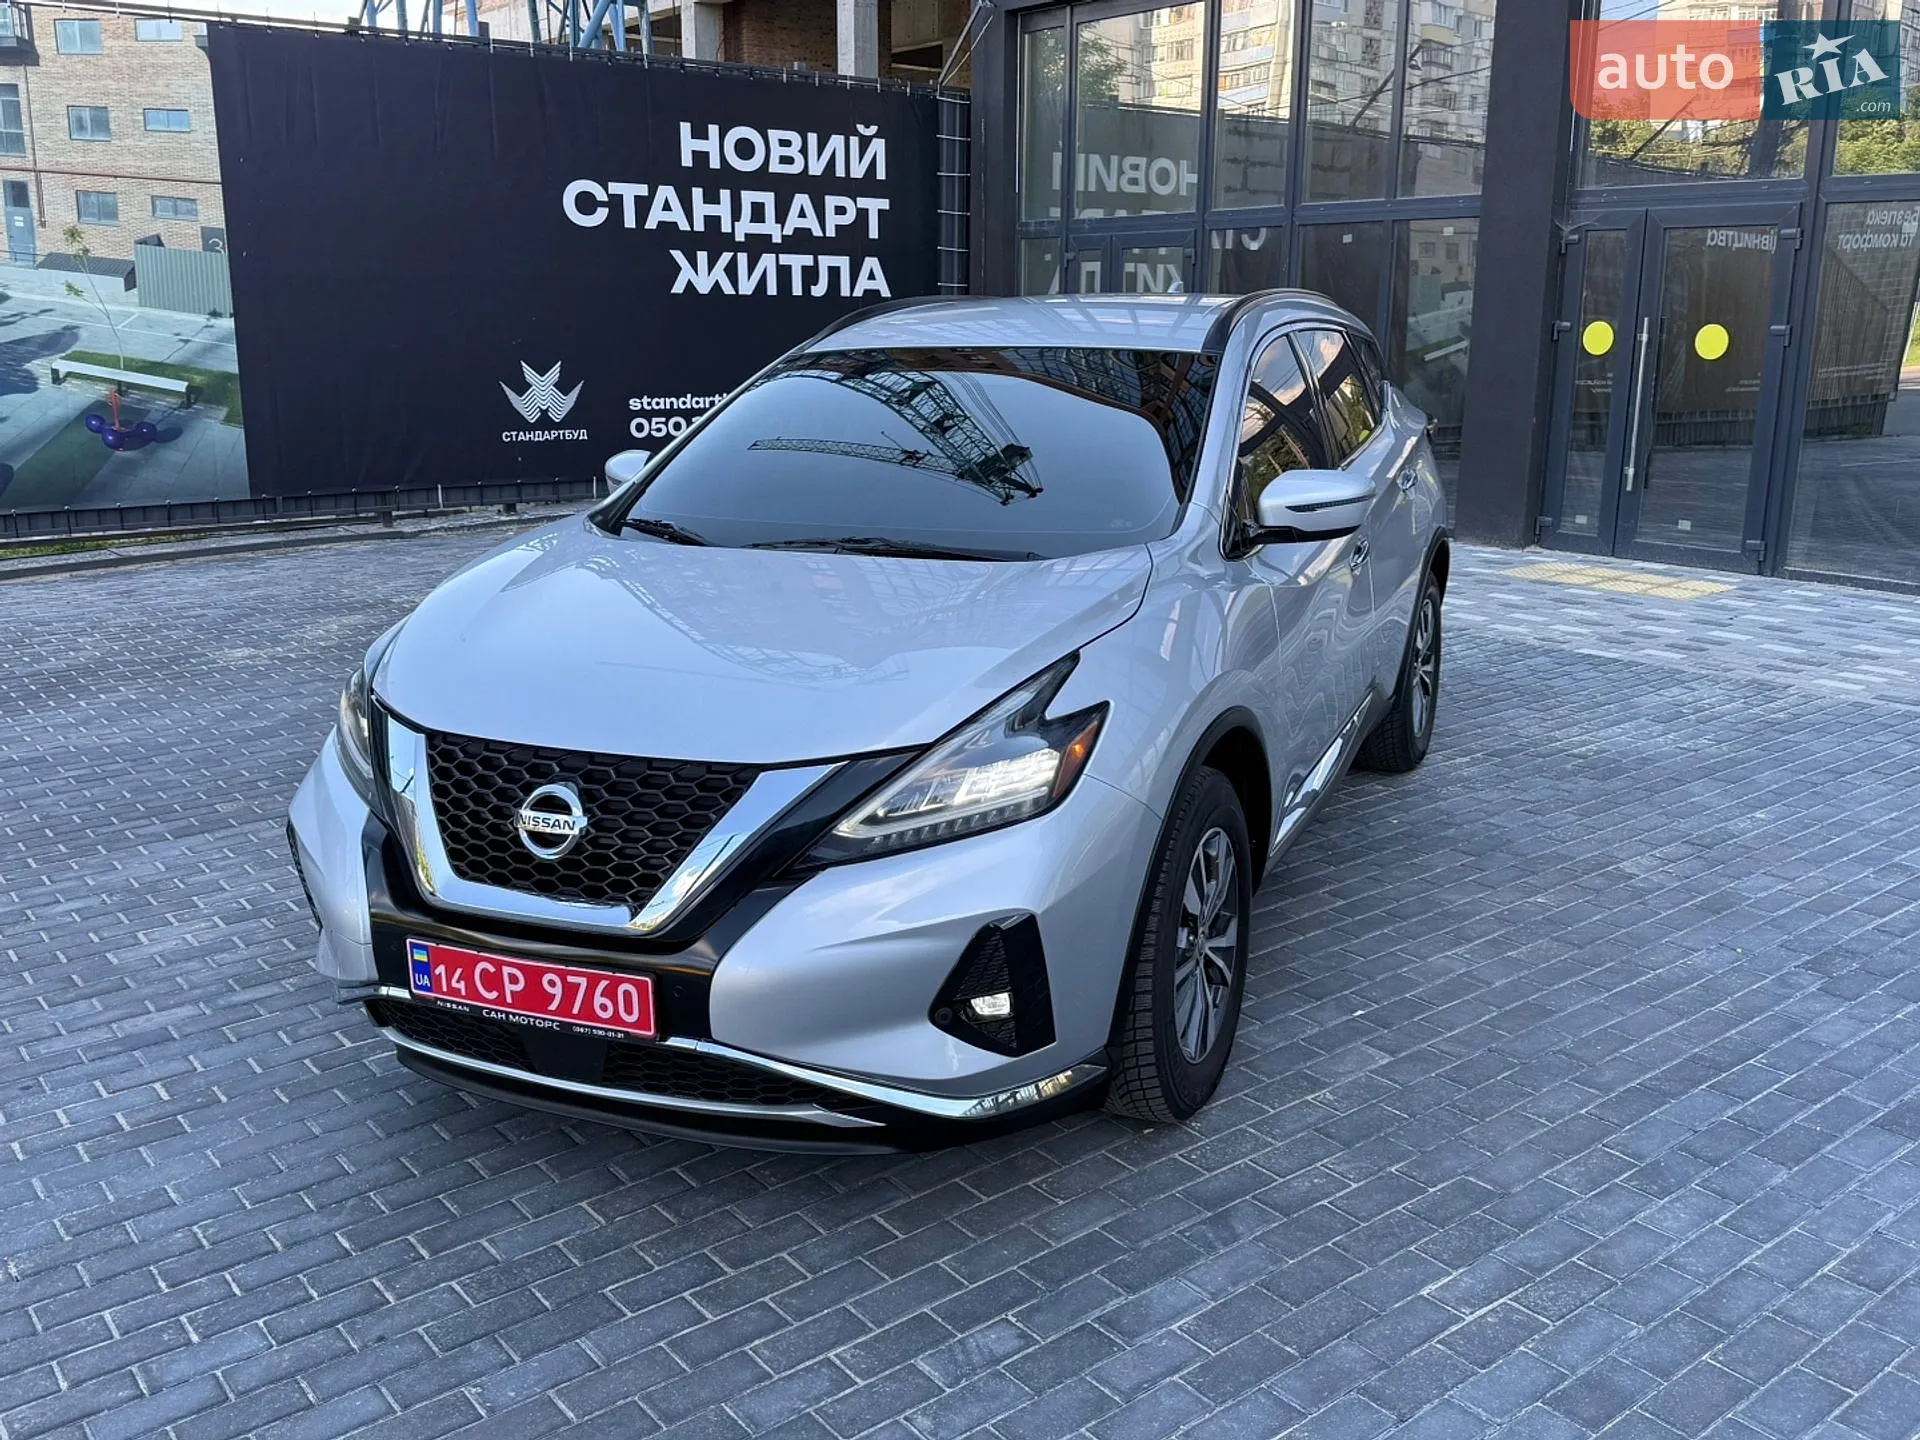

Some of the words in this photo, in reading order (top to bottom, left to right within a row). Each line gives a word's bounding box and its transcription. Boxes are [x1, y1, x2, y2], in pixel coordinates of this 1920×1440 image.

[680, 121, 887, 180] НОВИЙ
[562, 179, 890, 243] СТАНДАРТ
[669, 249, 892, 298] ЖИТЛА
[628, 393, 727, 410] standart
[502, 428, 588, 443] СТАНДАРТБУД
[518, 812, 576, 831] NISSAN
[415, 972, 431, 988] UA
[437, 1000, 470, 1012] NISSAN
[541, 975, 639, 1023] 9760
[482, 1009, 506, 1021] САН
[508, 1014, 560, 1031] МОТОРС
